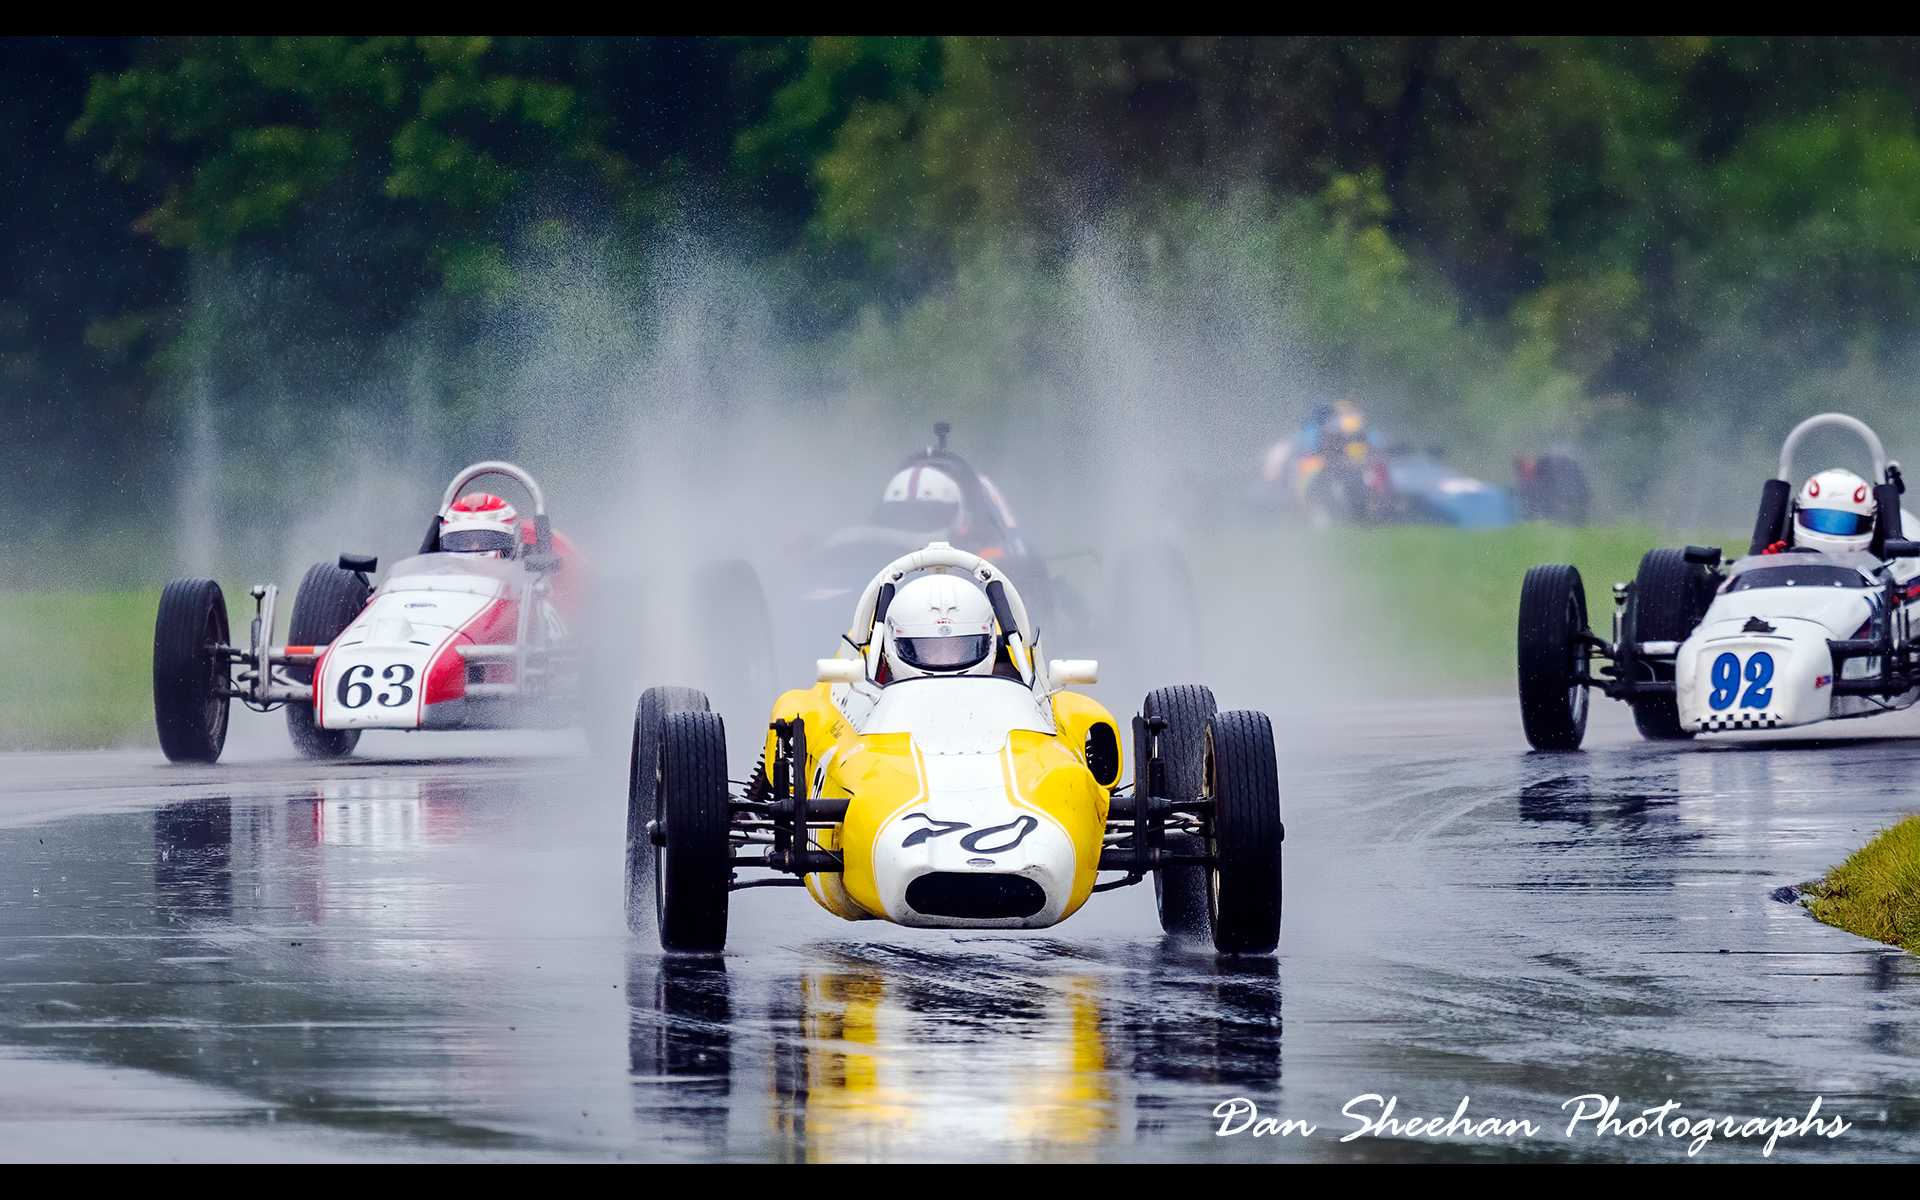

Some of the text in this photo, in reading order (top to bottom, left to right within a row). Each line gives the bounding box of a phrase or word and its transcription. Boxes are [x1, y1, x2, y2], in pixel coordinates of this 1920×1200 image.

[338, 664, 414, 708] 63
[1709, 652, 1774, 711] 92
[901, 812, 1038, 854] 70
